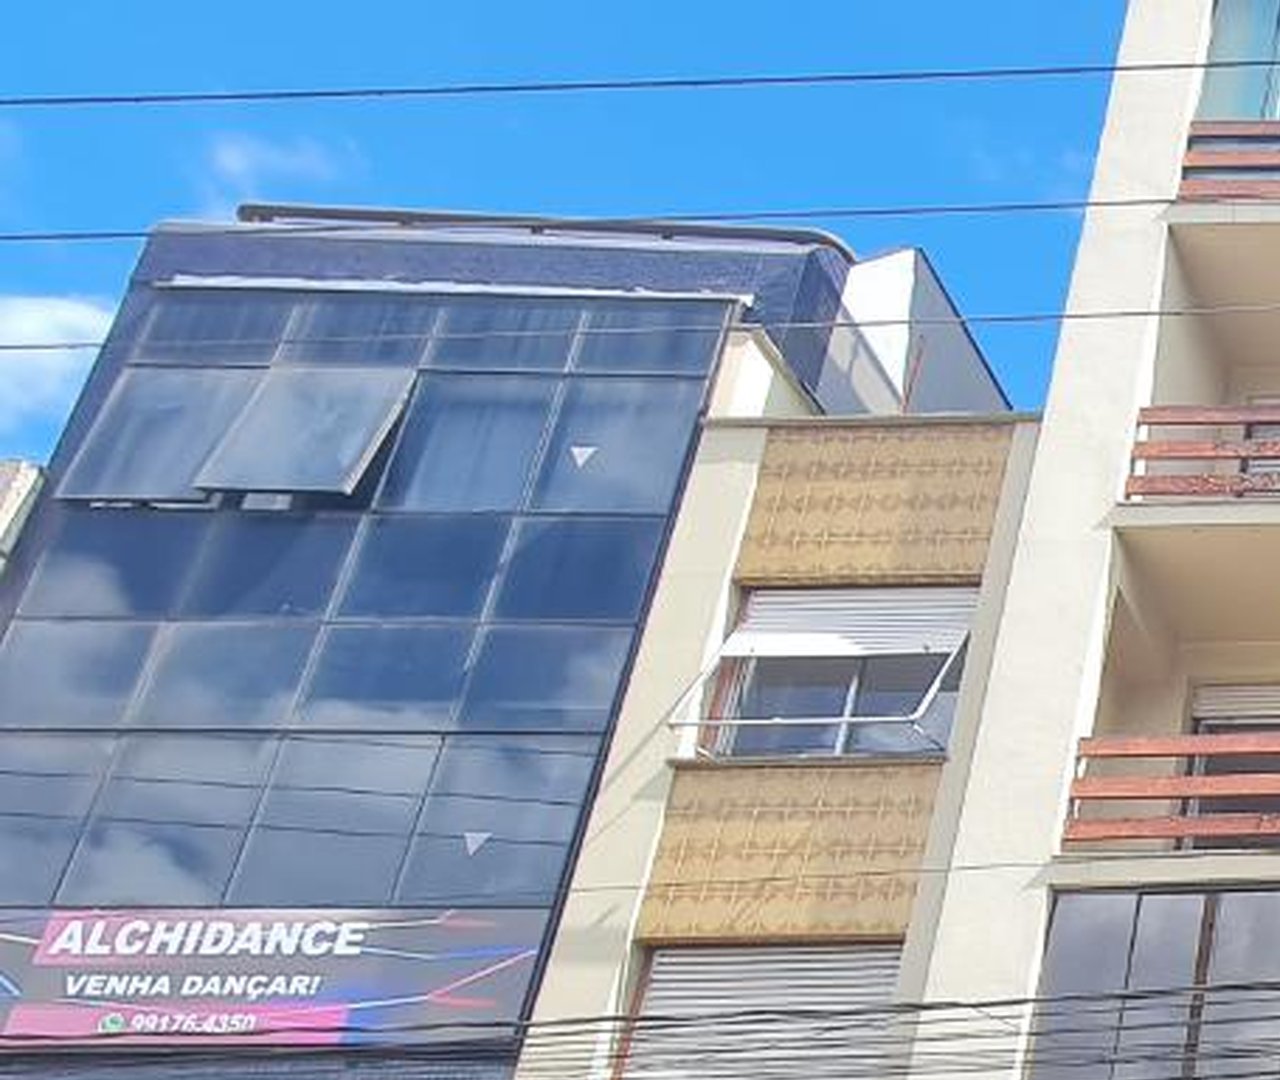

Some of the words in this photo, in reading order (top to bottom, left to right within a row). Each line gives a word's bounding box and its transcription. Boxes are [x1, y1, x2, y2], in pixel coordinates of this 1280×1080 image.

[49, 920, 370, 957] ALCHIDANCE
[65, 974, 172, 997] VENHA
[180, 973, 321, 1001] DANÇAR!
